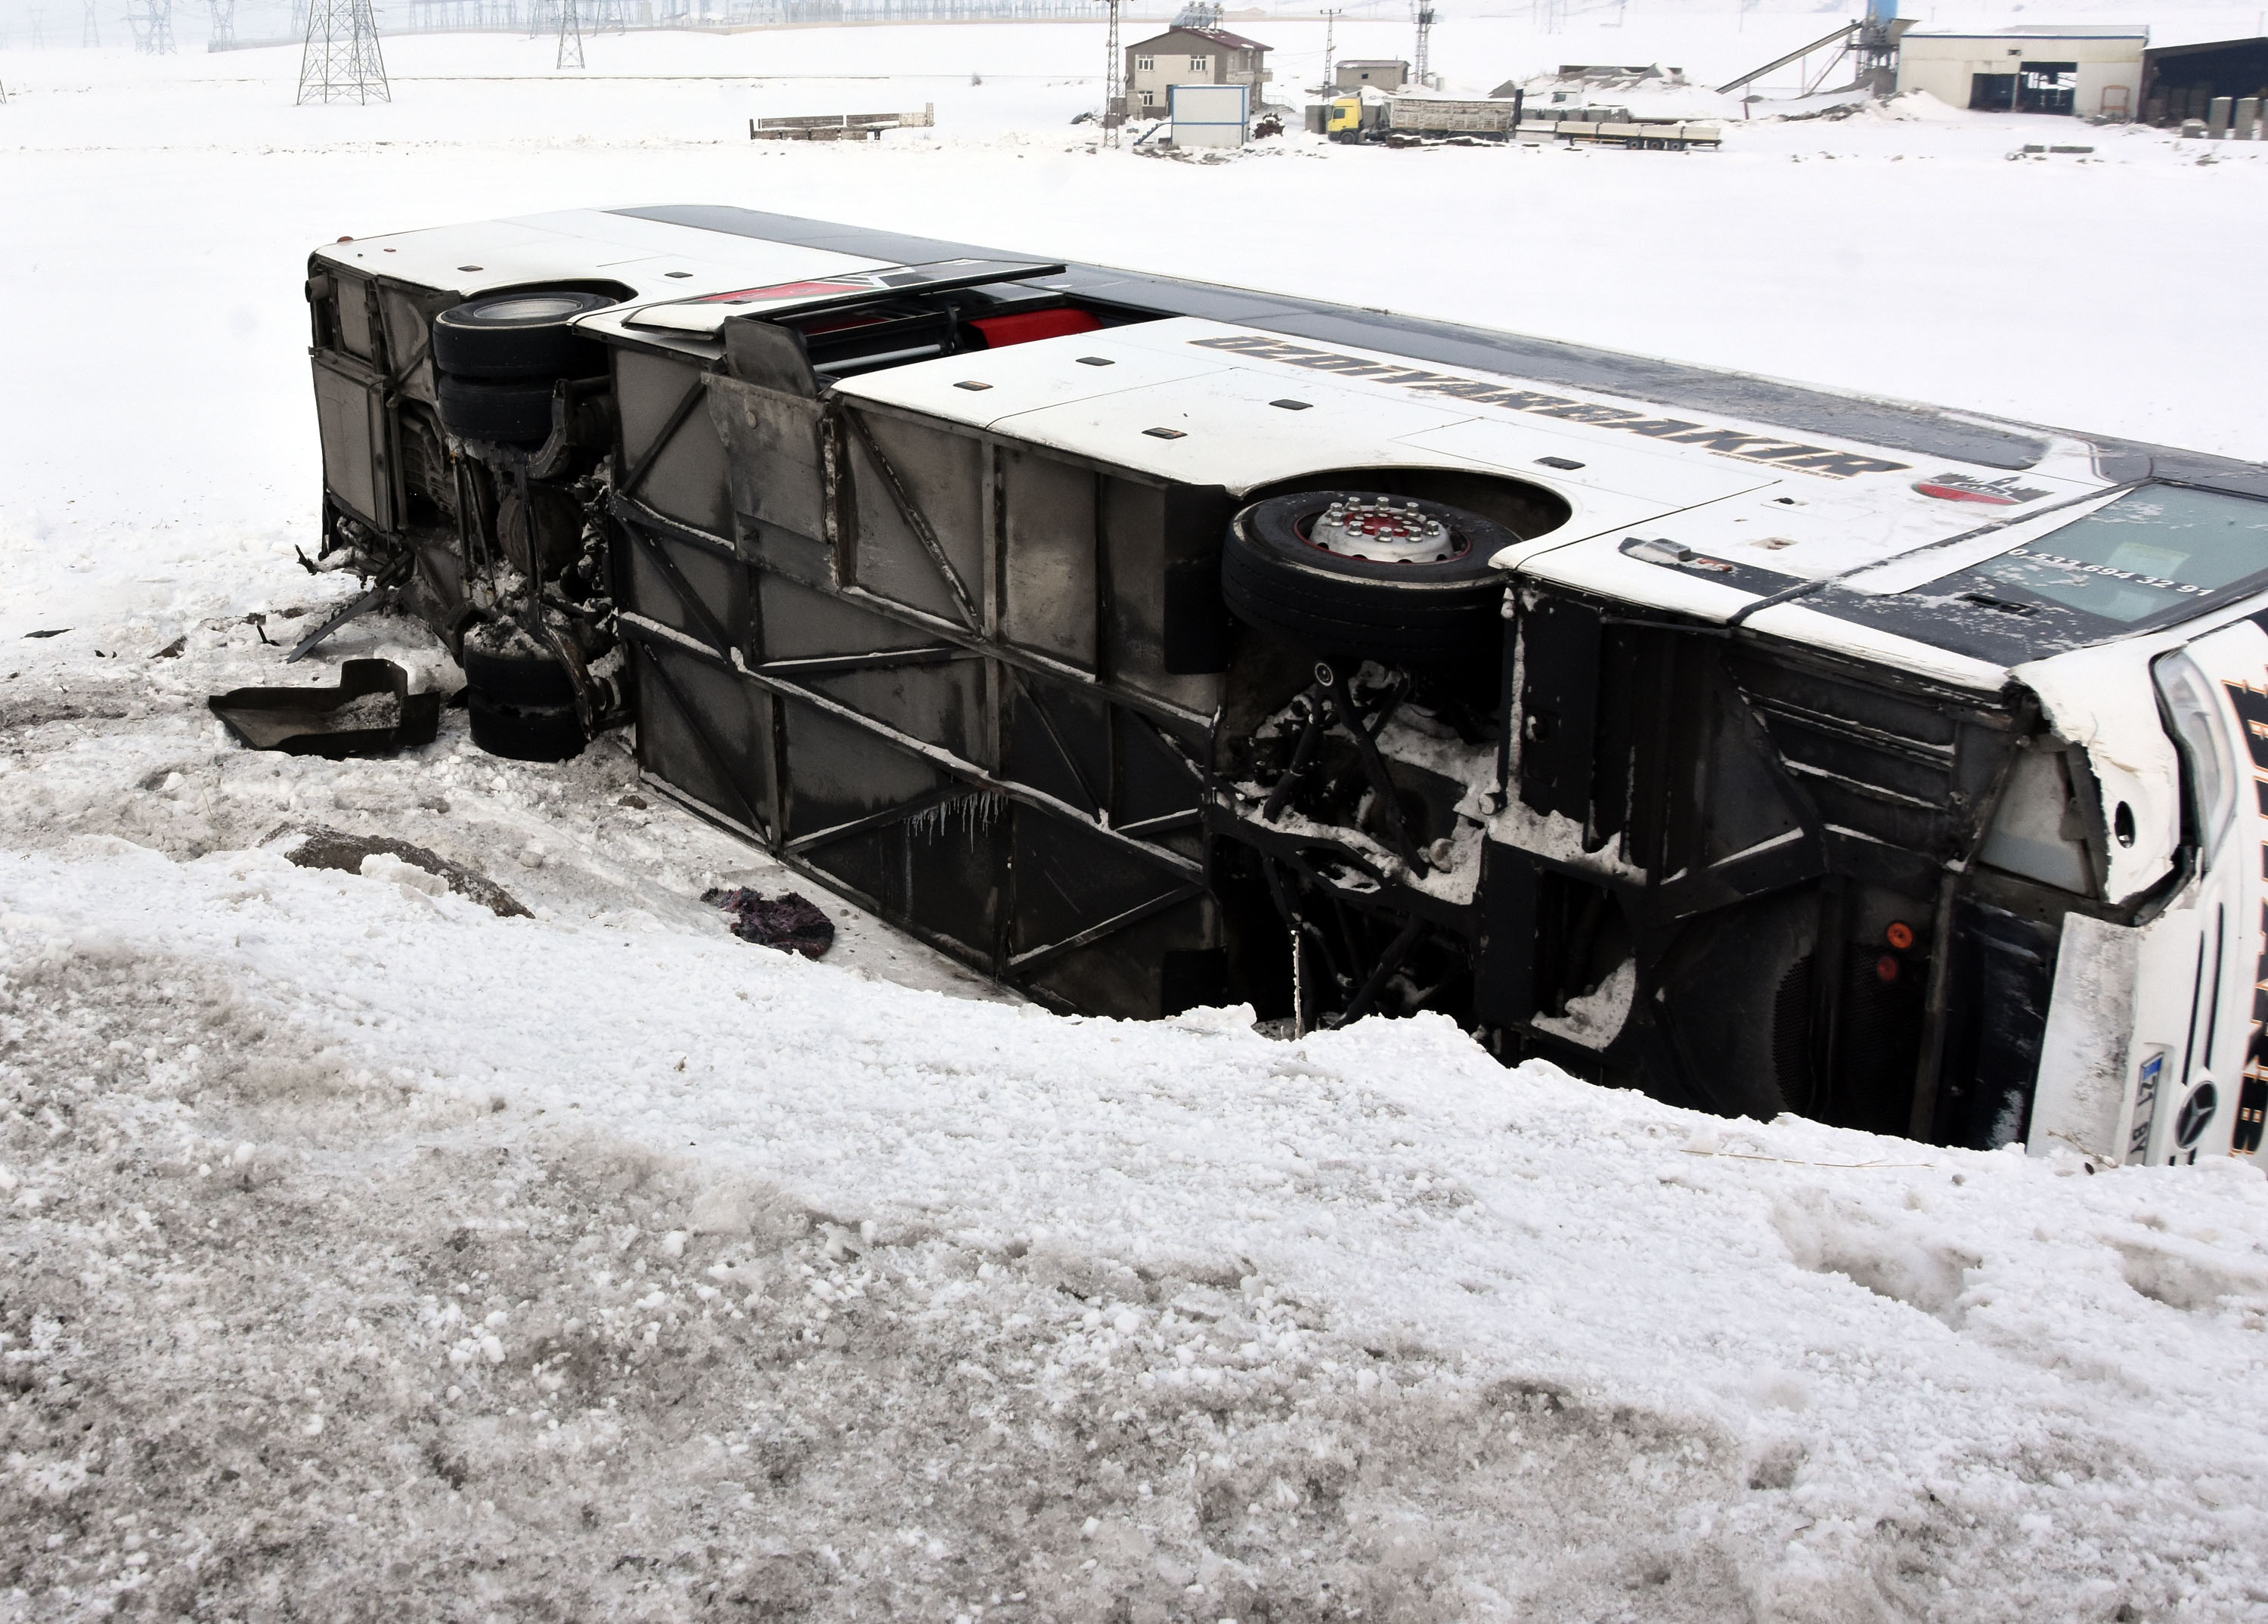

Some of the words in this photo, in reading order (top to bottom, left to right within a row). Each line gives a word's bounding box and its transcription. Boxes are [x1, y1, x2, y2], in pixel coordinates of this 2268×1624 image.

[2083, 565, 2136, 579] 694
[2136, 576, 2175, 588] 32
[2177, 585, 2215, 596] 91
[2137, 1075, 2157, 1107] 21
